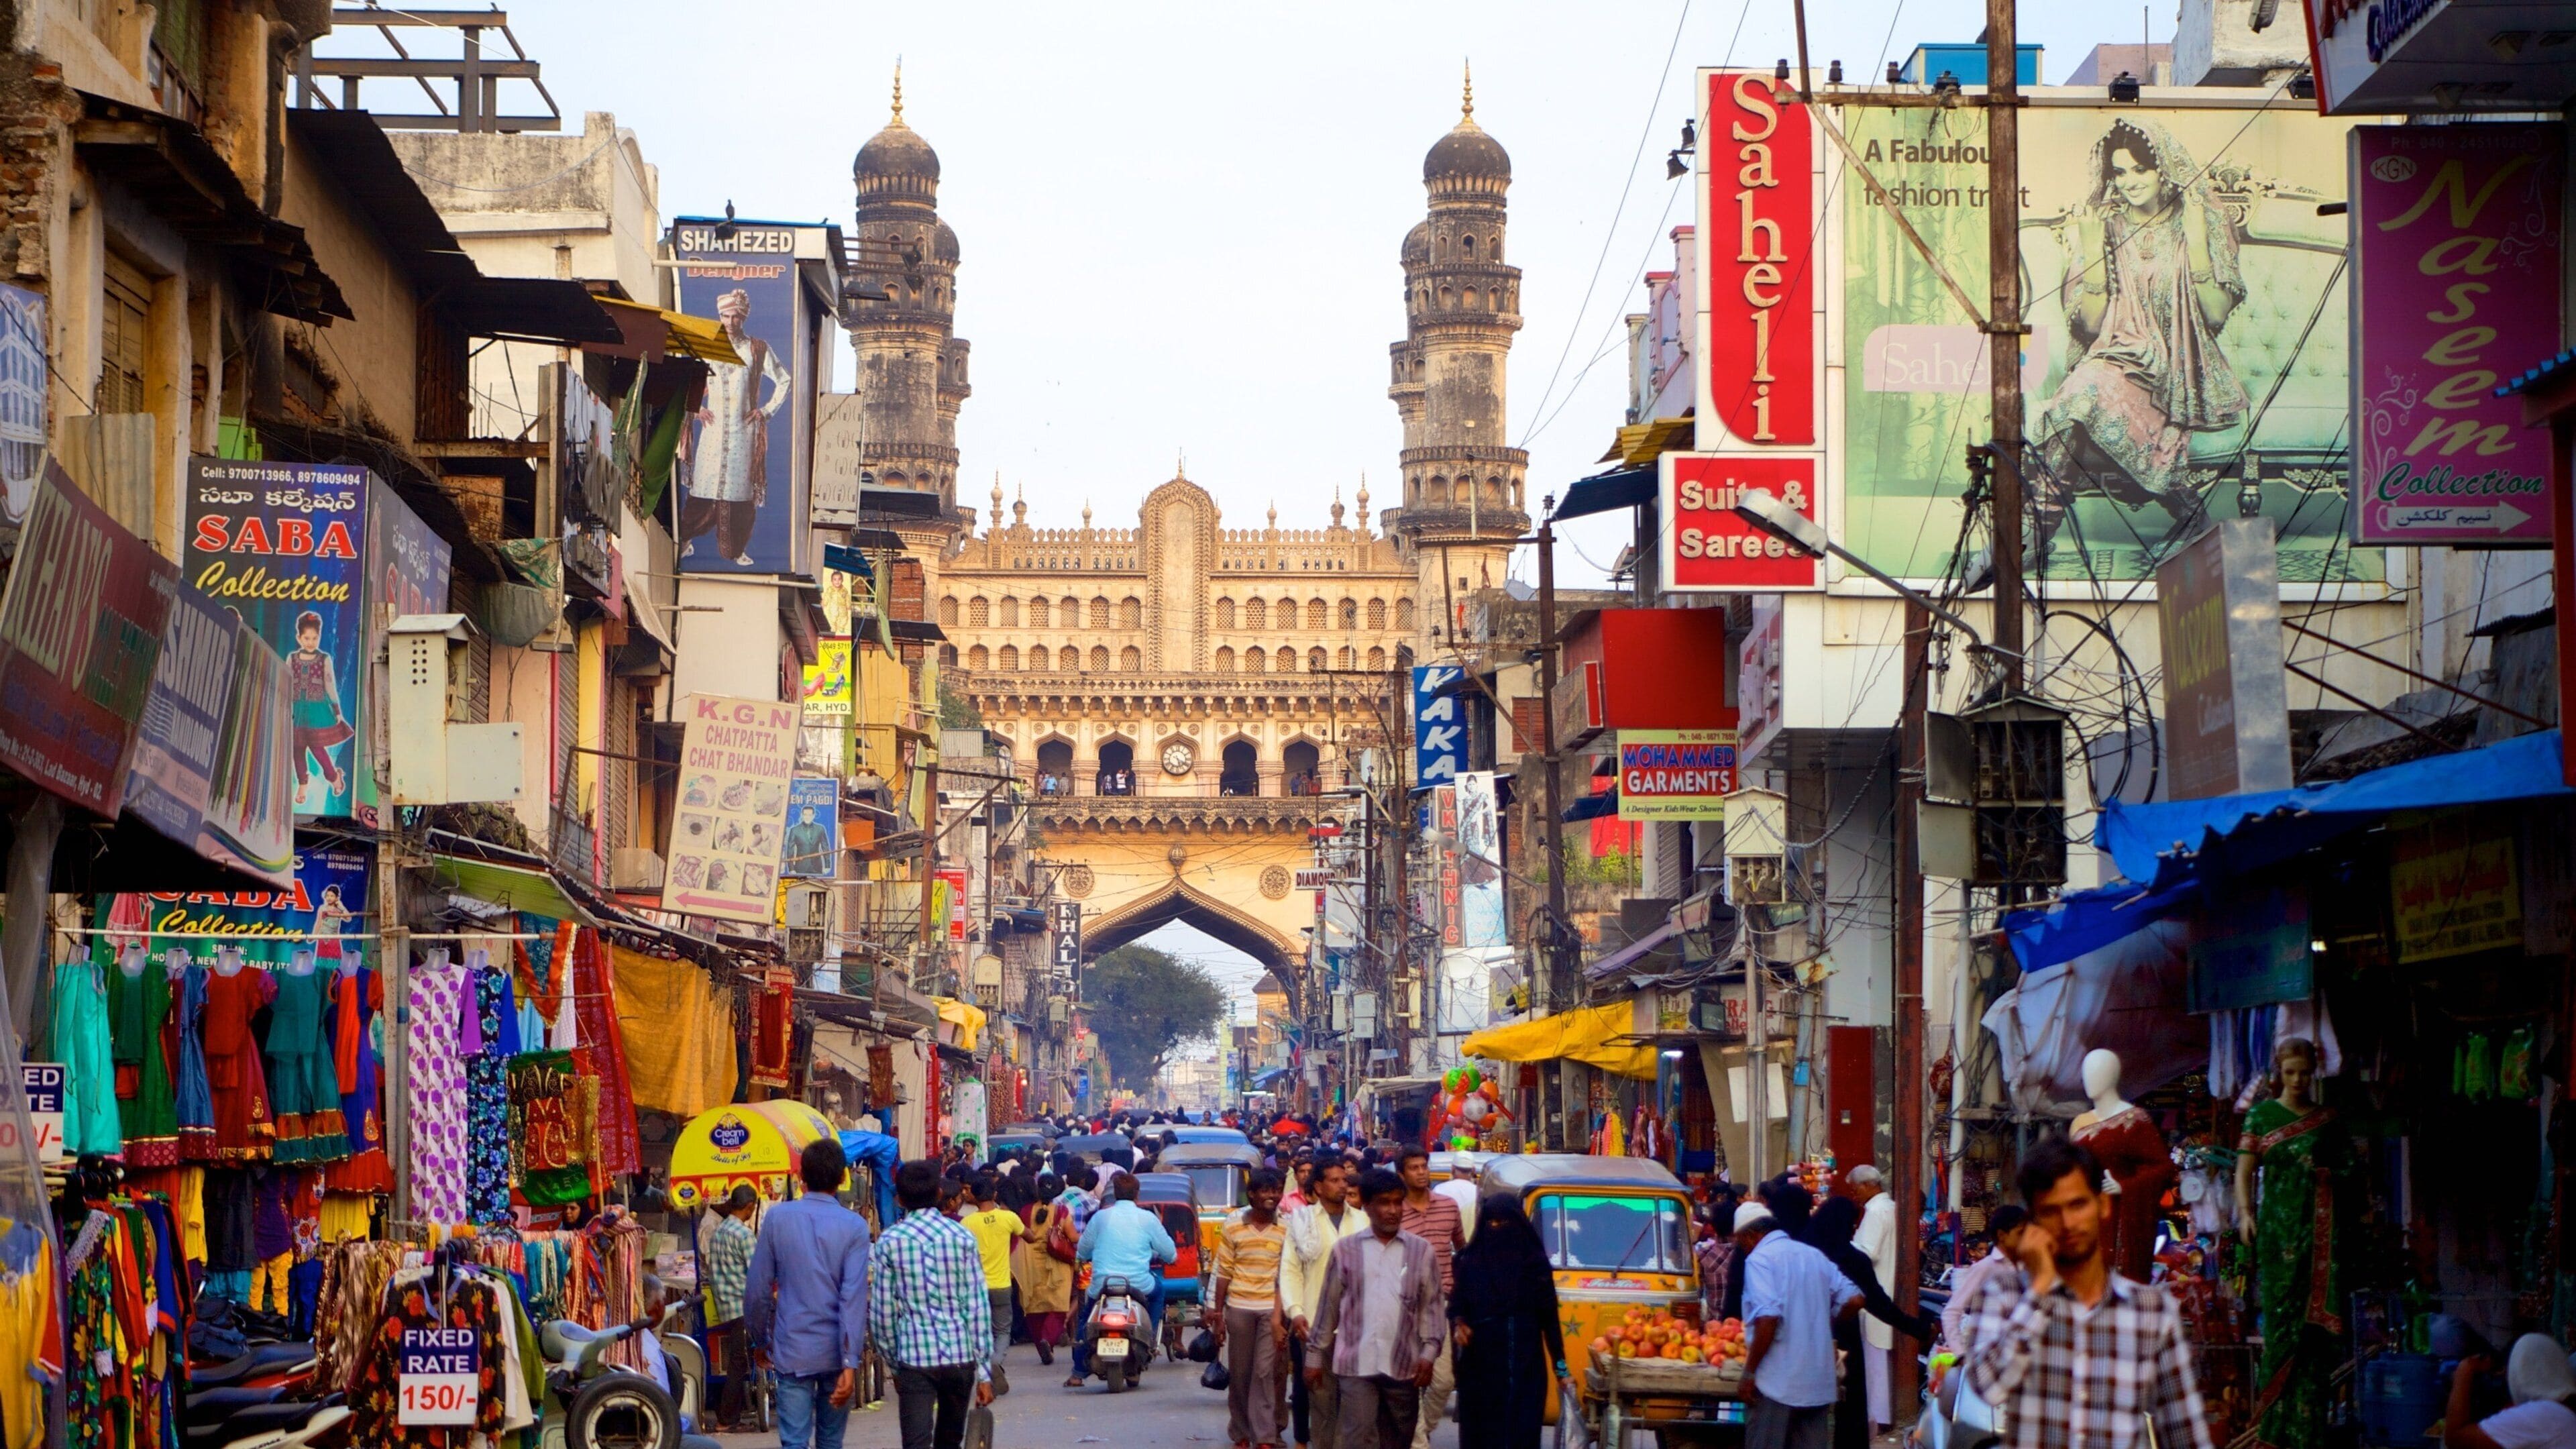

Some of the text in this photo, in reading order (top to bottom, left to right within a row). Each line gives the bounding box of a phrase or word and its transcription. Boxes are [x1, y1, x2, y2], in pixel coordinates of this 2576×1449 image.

[1864, 139, 1990, 164] A Fabulou
[2375, 158, 2414, 180] KGN
[1967, 186, 2031, 208] trt
[681, 230, 794, 253] SHAHEZED
[1732, 73, 1788, 441] Saheli
[2377, 155, 2539, 456] Naseem
[202, 466, 360, 485] Cell: 9700713966, 8978609494
[2377, 462, 2544, 502] Collection
[1781, 480, 1808, 511] &
[193, 514, 358, 559] SABA
[195, 561, 350, 602] Collection
[697, 699, 792, 730] K.G.N
[826, 703, 851, 712] HYD.
[1419, 668, 1462, 780] KAKA
[706, 724, 777, 753] CHATPATTA
[690, 747, 788, 779] CHAT BHANDAR
[1623, 745, 1735, 769] MOHAMMED
[1627, 771, 1730, 793] GARMENTS
[1631, 805, 1662, 814] Designer
[157, 909, 305, 943] Collection
[197, 957, 218, 966] NEW
[714, 1129, 745, 1138] Cream
[722, 1136, 739, 1146] bell
[711, 1152, 731, 1164] Bells
[731, 1153, 740, 1165] of
[983, 1215, 996, 1225] 02
[405, 1329, 474, 1348] FIXED
[408, 1355, 470, 1373] RATE
[403, 1385, 476, 1410] 150/-
